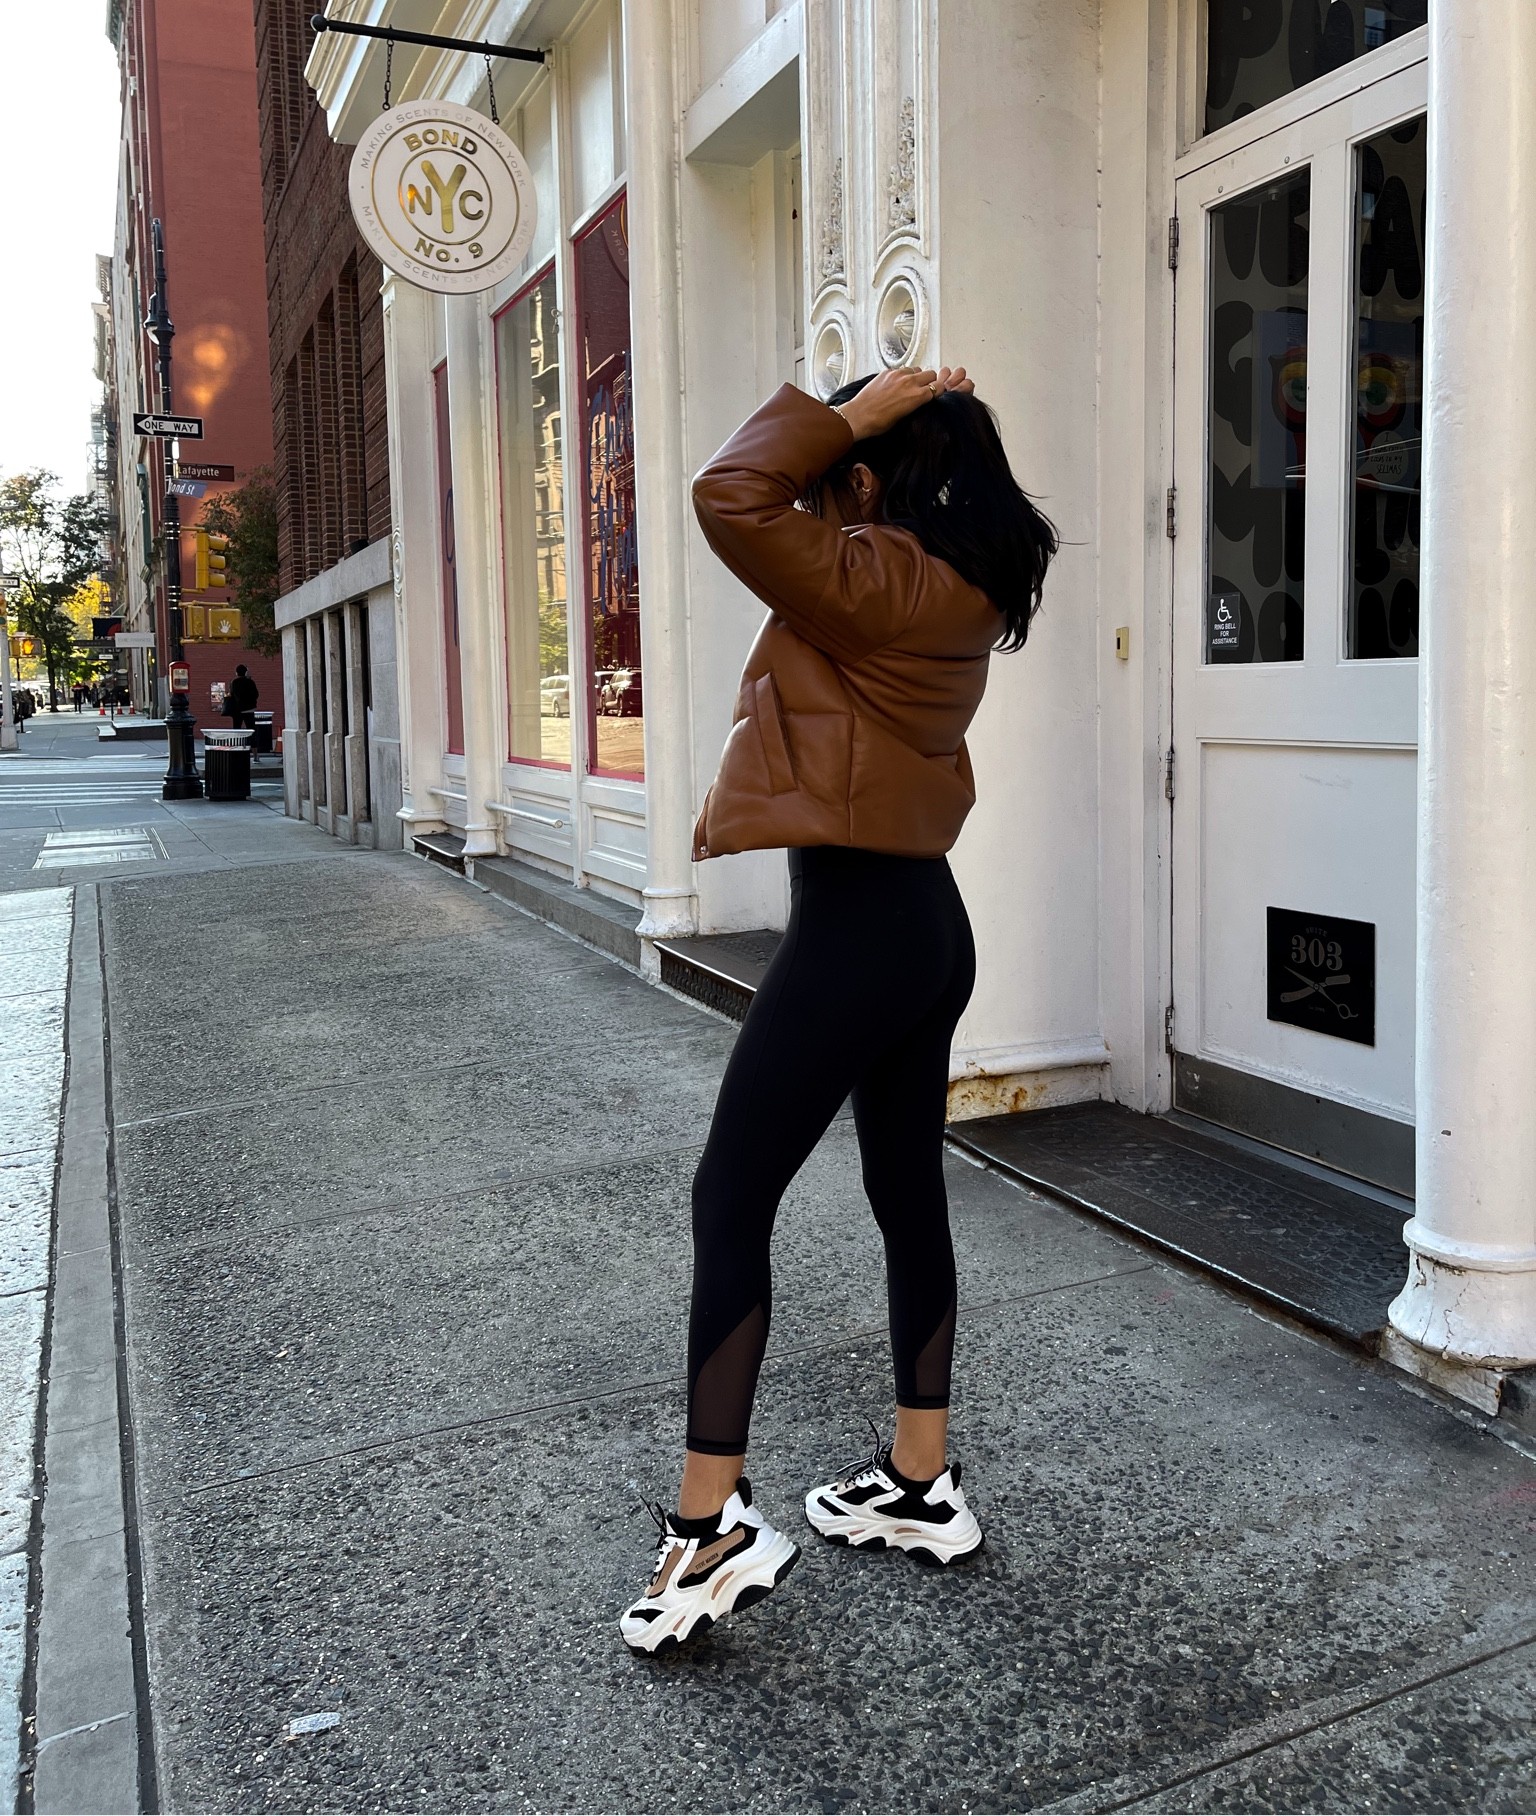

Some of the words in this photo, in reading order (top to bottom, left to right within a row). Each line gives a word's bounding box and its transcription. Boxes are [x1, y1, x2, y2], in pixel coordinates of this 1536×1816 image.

[361, 122, 393, 169] MAKING
[395, 108, 449, 124] SCENTS
[455, 112, 473, 124] OF
[477, 122, 506, 149] NEW
[506, 151, 526, 187] YORK
[403, 128, 479, 156] BOND
[407, 160, 484, 234] NYC
[362, 205, 398, 258] MAKIG
[402, 260, 458, 284] SCENTS
[486, 257, 512, 277] NEW
[468, 242, 484, 259] 9
[144, 420, 165, 430] ONE
[173, 423, 194, 432] WAY
[178, 466, 219, 477] Lafayette
[170, 482, 186, 494] ond
[186, 484, 195, 495] St
[1225, 622, 1236, 630] BELL
[1212, 637, 1238, 645] ASSISTANCE
[1291, 934, 1343, 971] 303
